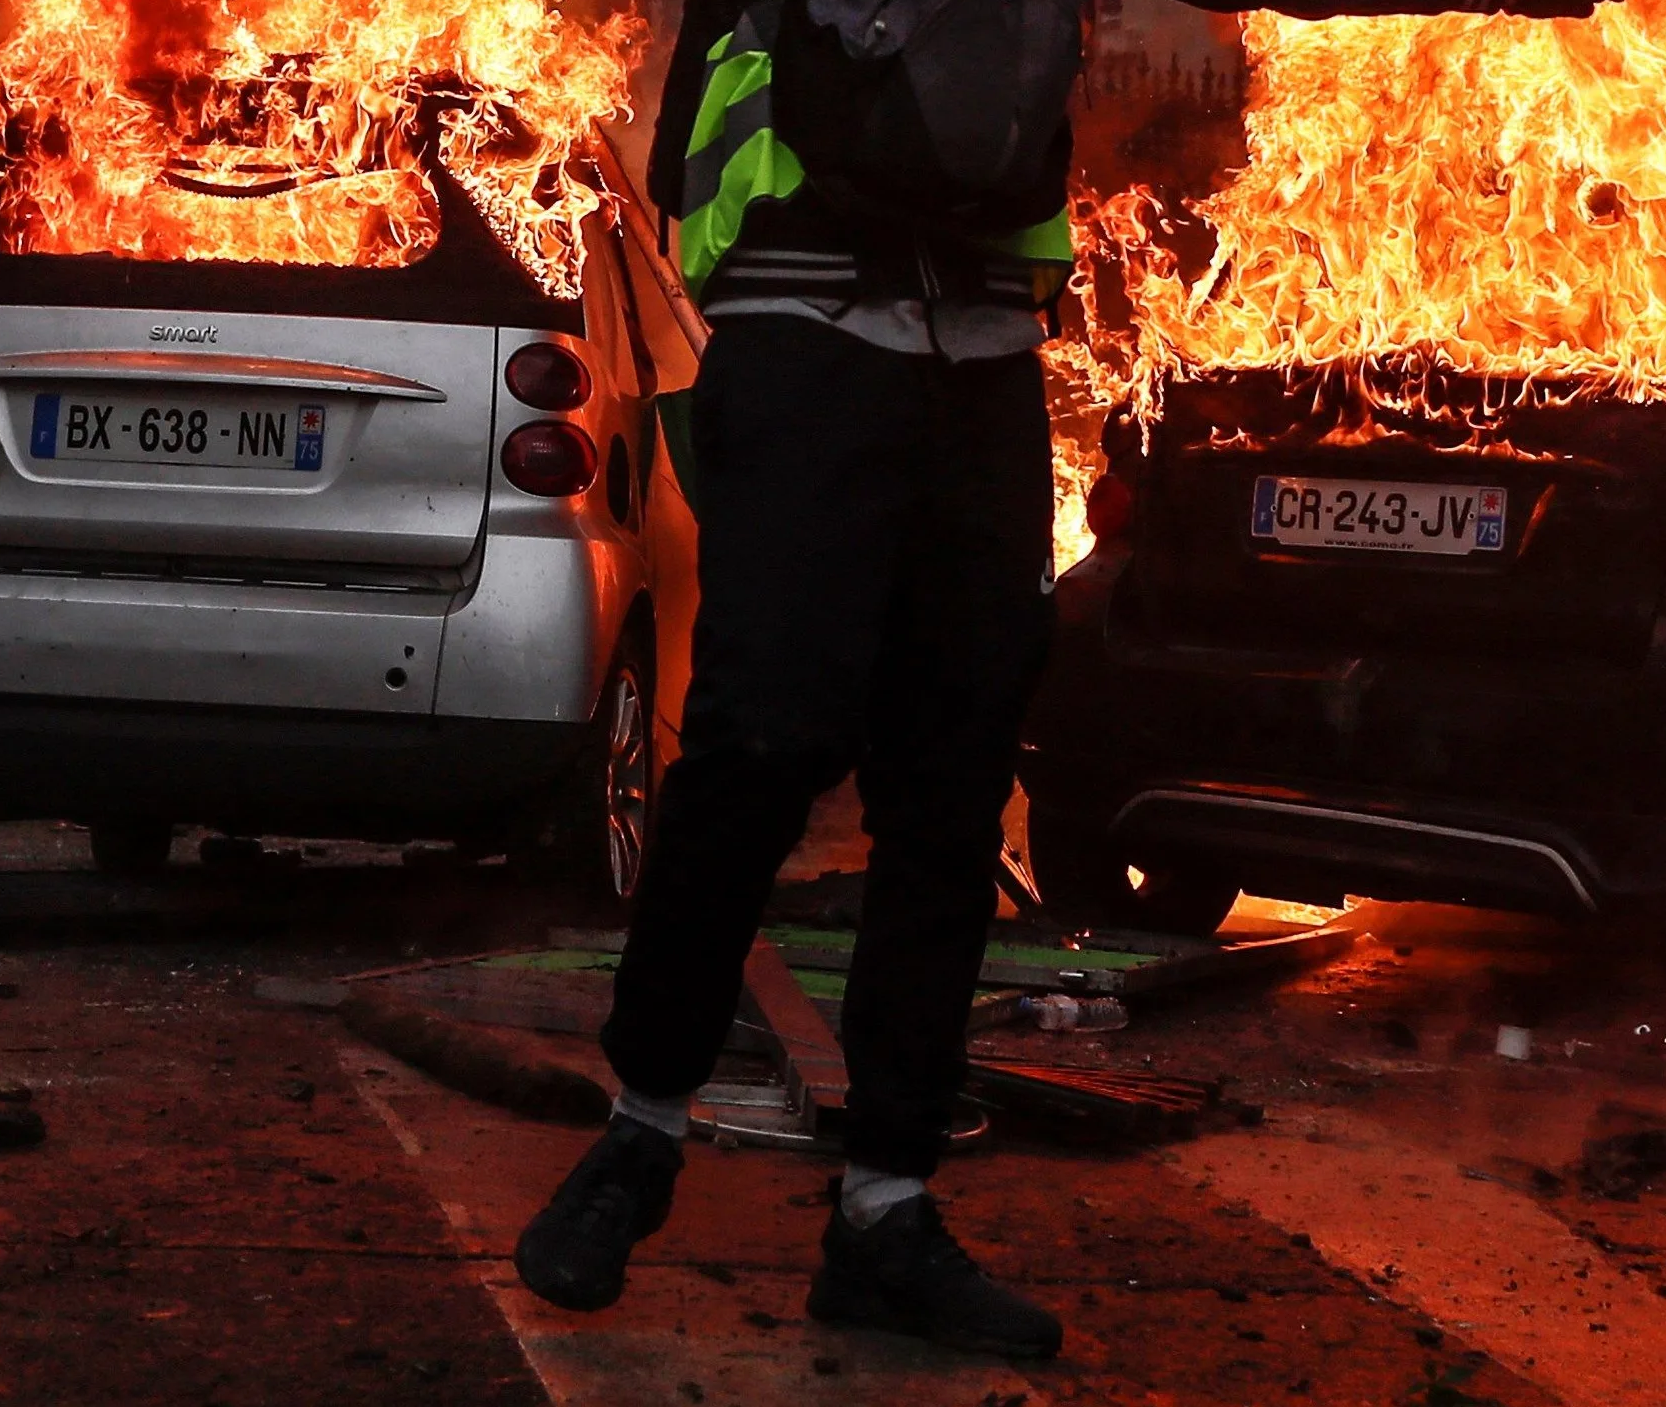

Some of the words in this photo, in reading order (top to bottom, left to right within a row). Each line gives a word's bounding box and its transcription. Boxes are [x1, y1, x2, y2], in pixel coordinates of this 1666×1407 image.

[149, 323, 220, 344] smart
[300, 440, 319, 461] 75
[1275, 487, 1474, 540] CR-243-JV
[1478, 521, 1499, 543] 75
